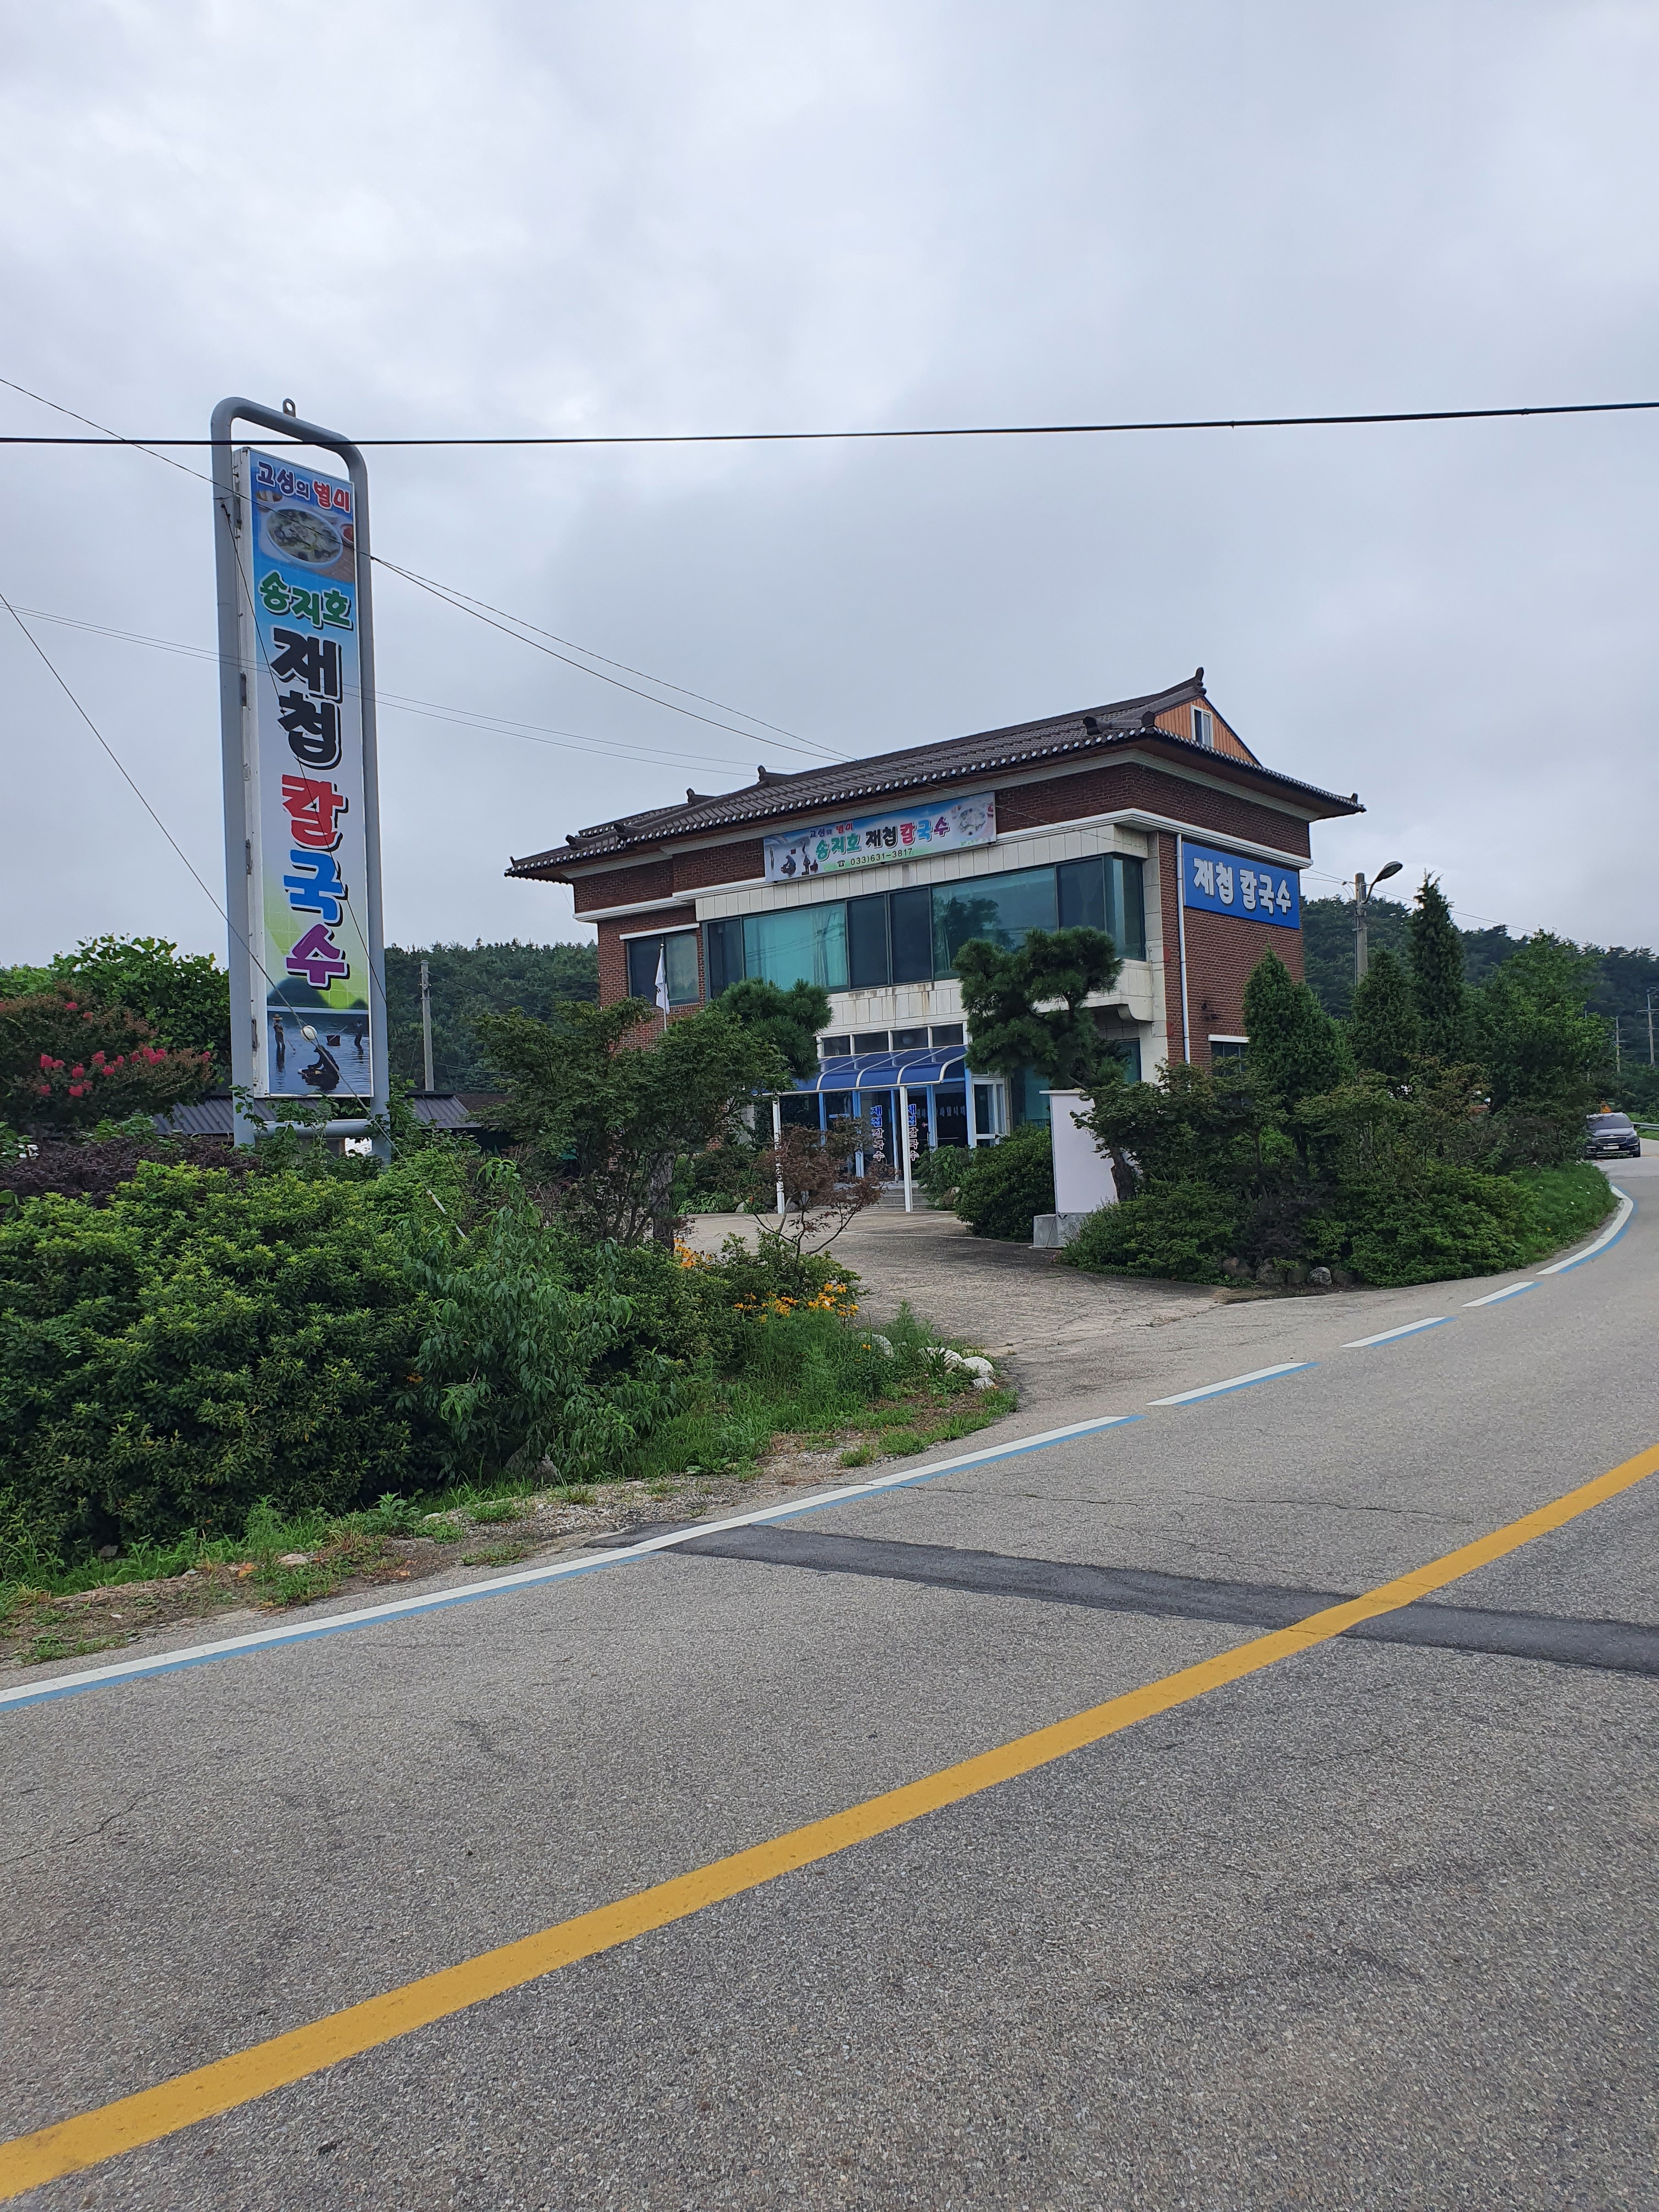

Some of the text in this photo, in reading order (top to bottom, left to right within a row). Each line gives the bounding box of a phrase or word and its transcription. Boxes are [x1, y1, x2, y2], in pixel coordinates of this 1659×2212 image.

[257, 460, 350, 512] 고성의 별미
[260, 571, 352, 630] 송지호
[270, 627, 349, 987] 재첩 칼국수
[810, 828, 833, 838] 고성의
[816, 833, 861, 861] 송지호
[851, 848, 912, 866] 033)631-3817
[1193, 857, 1291, 914] 재첩 칼국수
